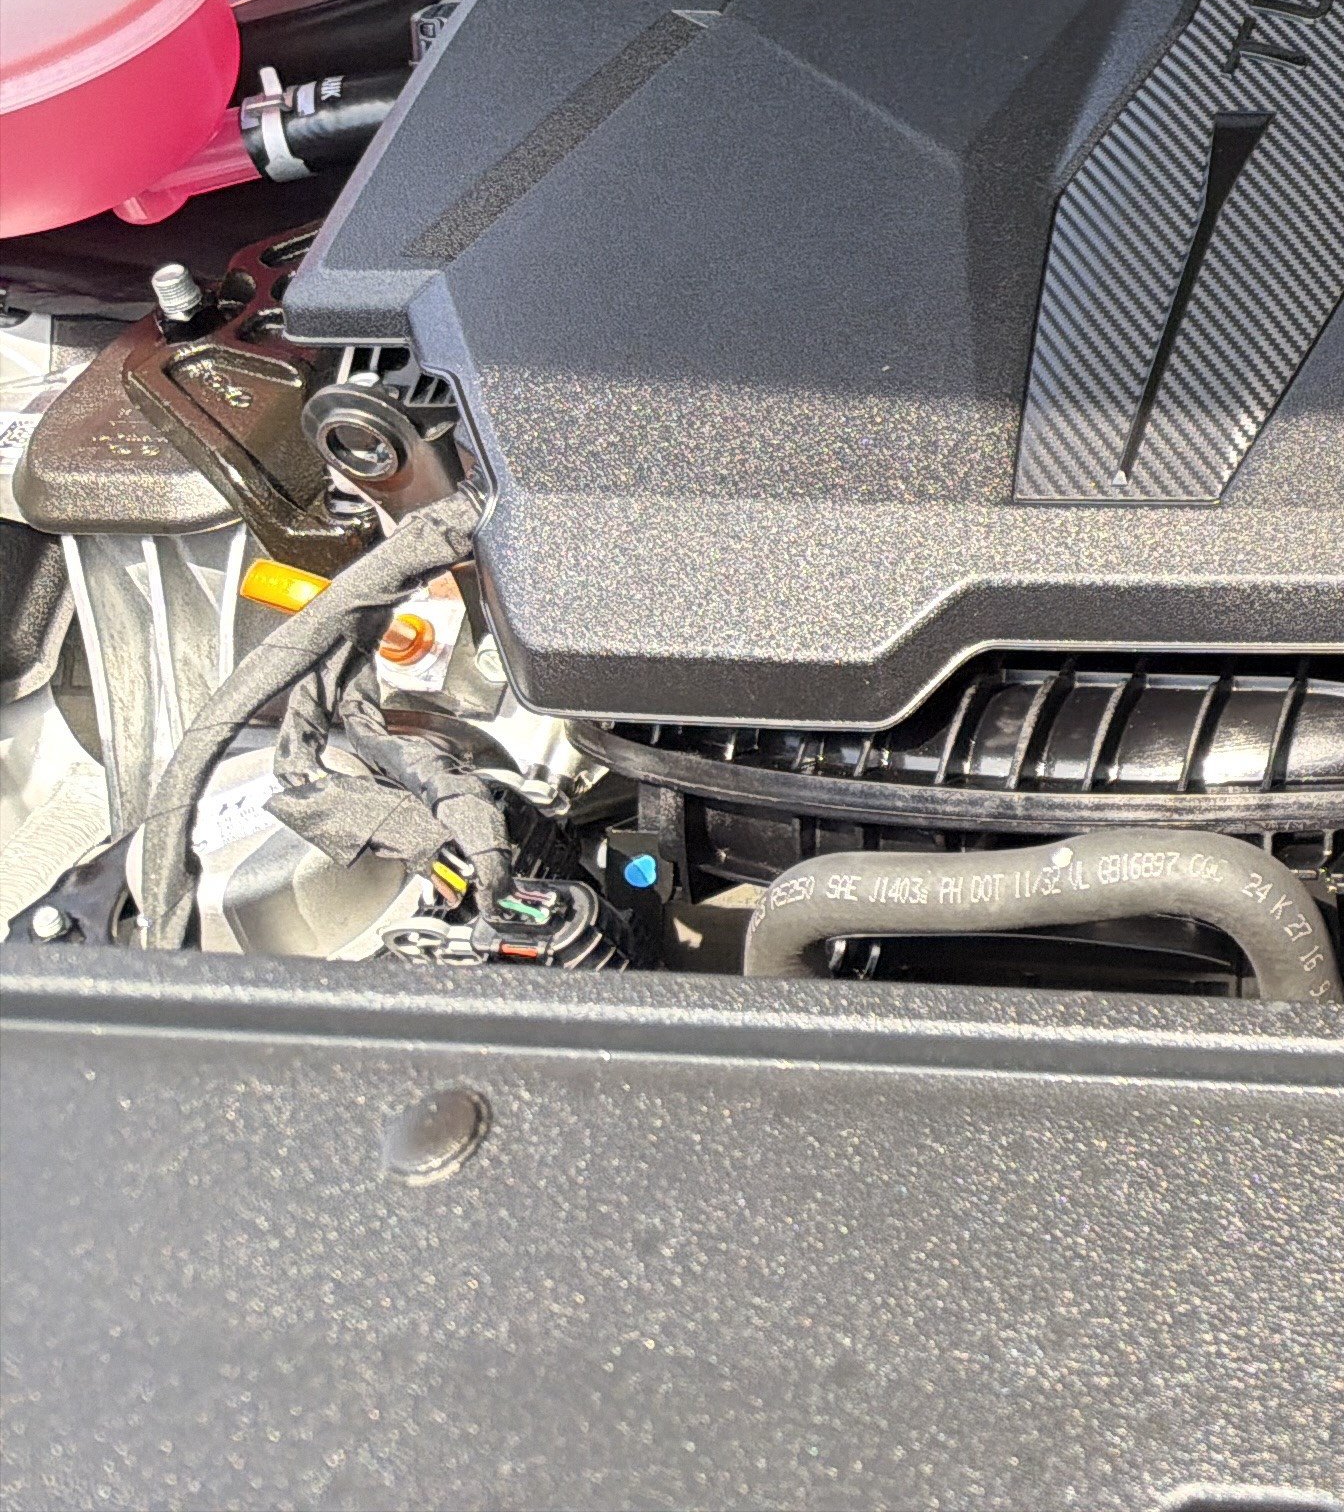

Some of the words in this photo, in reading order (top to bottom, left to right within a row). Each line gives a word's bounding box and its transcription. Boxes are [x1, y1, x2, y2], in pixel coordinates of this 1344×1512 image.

[826, 874, 862, 902] SAE
[938, 876, 965, 904] PH
[970, 874, 1005, 904] DOT
[1241, 872, 1275, 905] 24
[1269, 893, 1293, 921] K
[1298, 944, 1325, 973] 16
